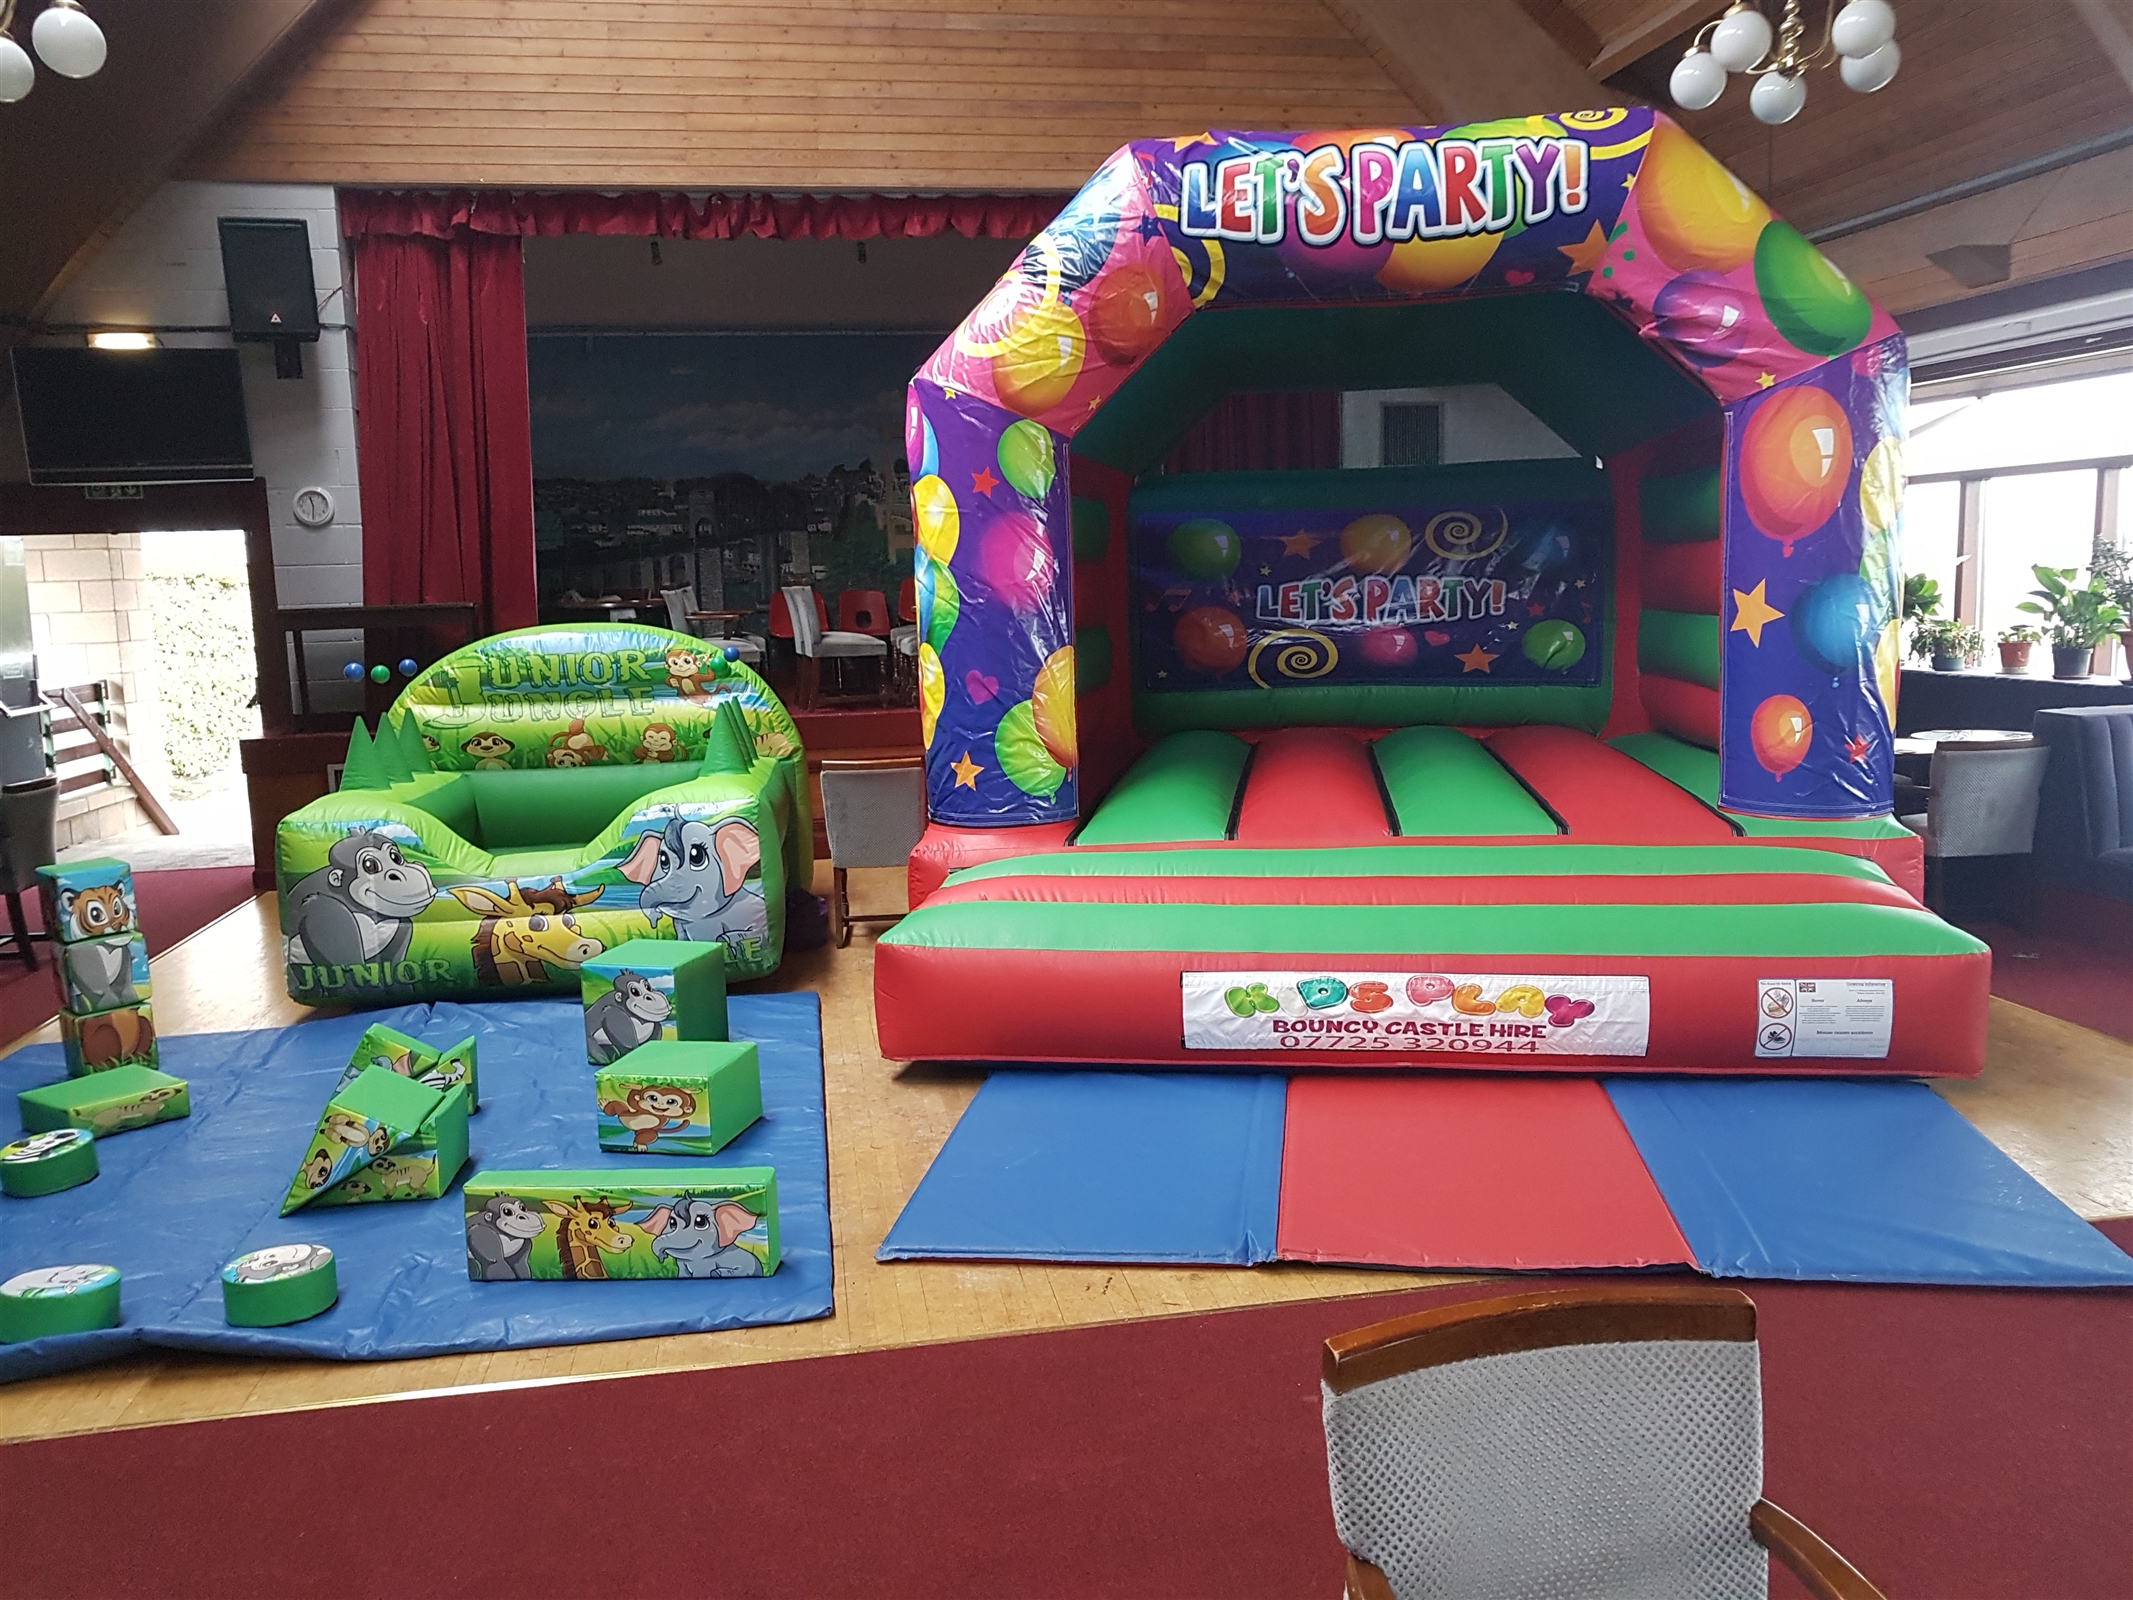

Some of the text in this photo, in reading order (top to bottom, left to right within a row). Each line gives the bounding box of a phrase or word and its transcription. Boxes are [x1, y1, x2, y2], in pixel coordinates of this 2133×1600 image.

[1180, 138, 1588, 245] LET'S PARTY!
[1254, 573, 1507, 625] LET'S PARTY!
[298, 957, 456, 990] JUNIOR
[1405, 974, 1595, 1027] PLAY
[1272, 1020, 1547, 1039] BOUNCY CASTLE HIRE
[1279, 1035, 1540, 1053] 07725 320944
